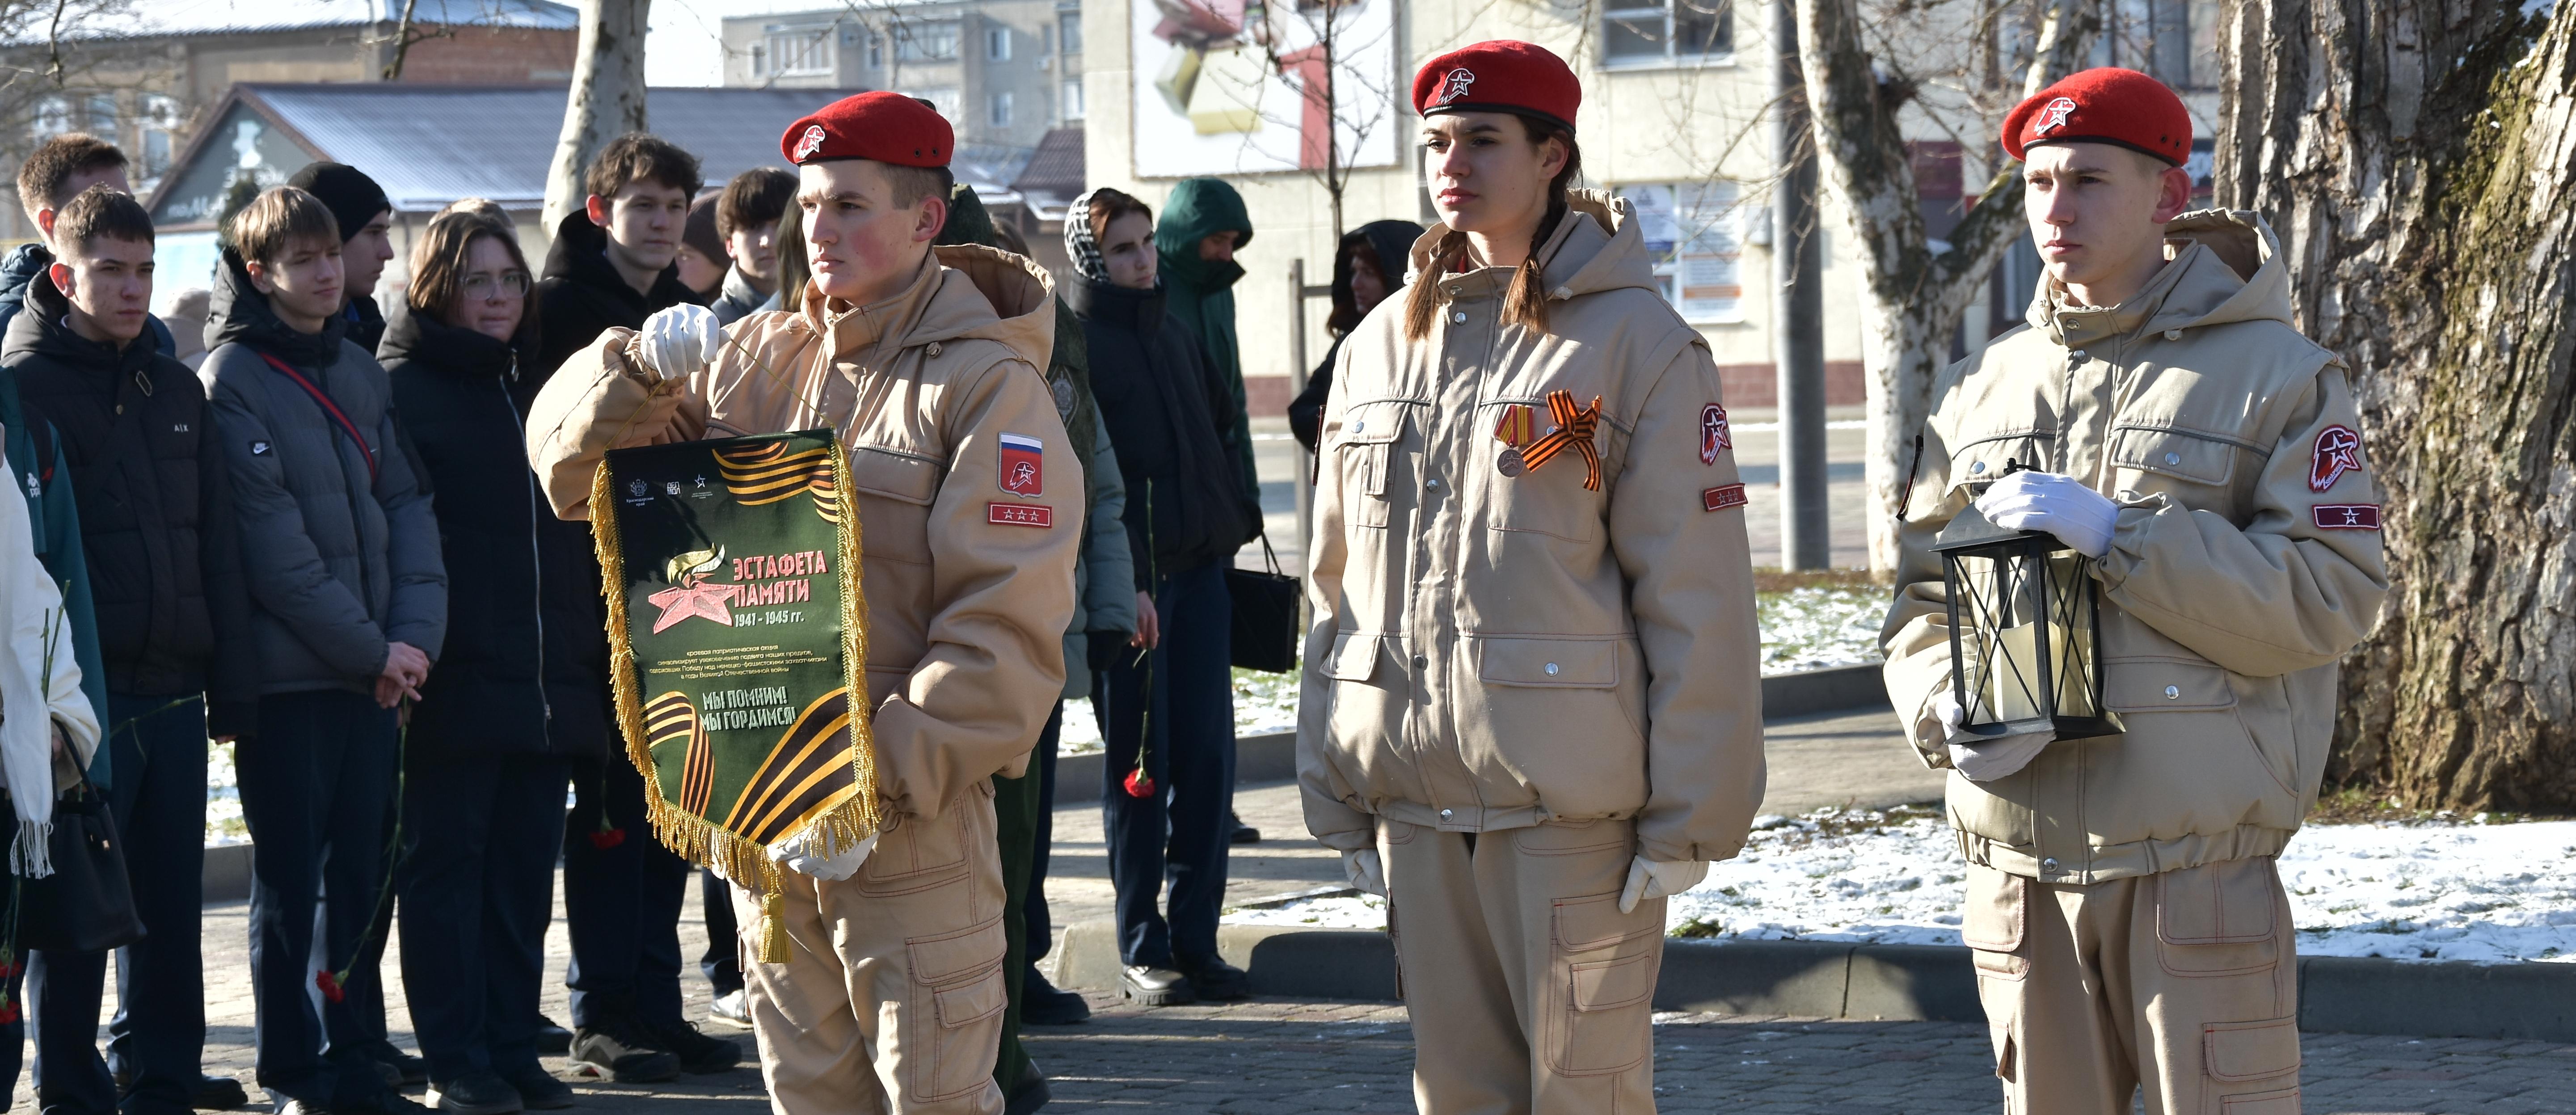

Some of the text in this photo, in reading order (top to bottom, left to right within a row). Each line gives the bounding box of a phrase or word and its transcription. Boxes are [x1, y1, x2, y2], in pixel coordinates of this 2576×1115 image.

[733, 550, 828, 581] ЭСТАФЕТА
[734, 579, 810, 608] ПАМЯТИ
[735, 613, 756, 627] 1941
[766, 610, 789, 625] 1945
[713, 646, 759, 655] патриотическая
[699, 655, 739, 664] увековечение
[717, 660, 784, 670] немецко-фашистскими
[725, 668, 770, 676] Отечественной
[702, 686, 788, 710] МЫ ПОМНИМ!
[700, 707, 797, 731] МЫ ГОРДИМСЯ!
